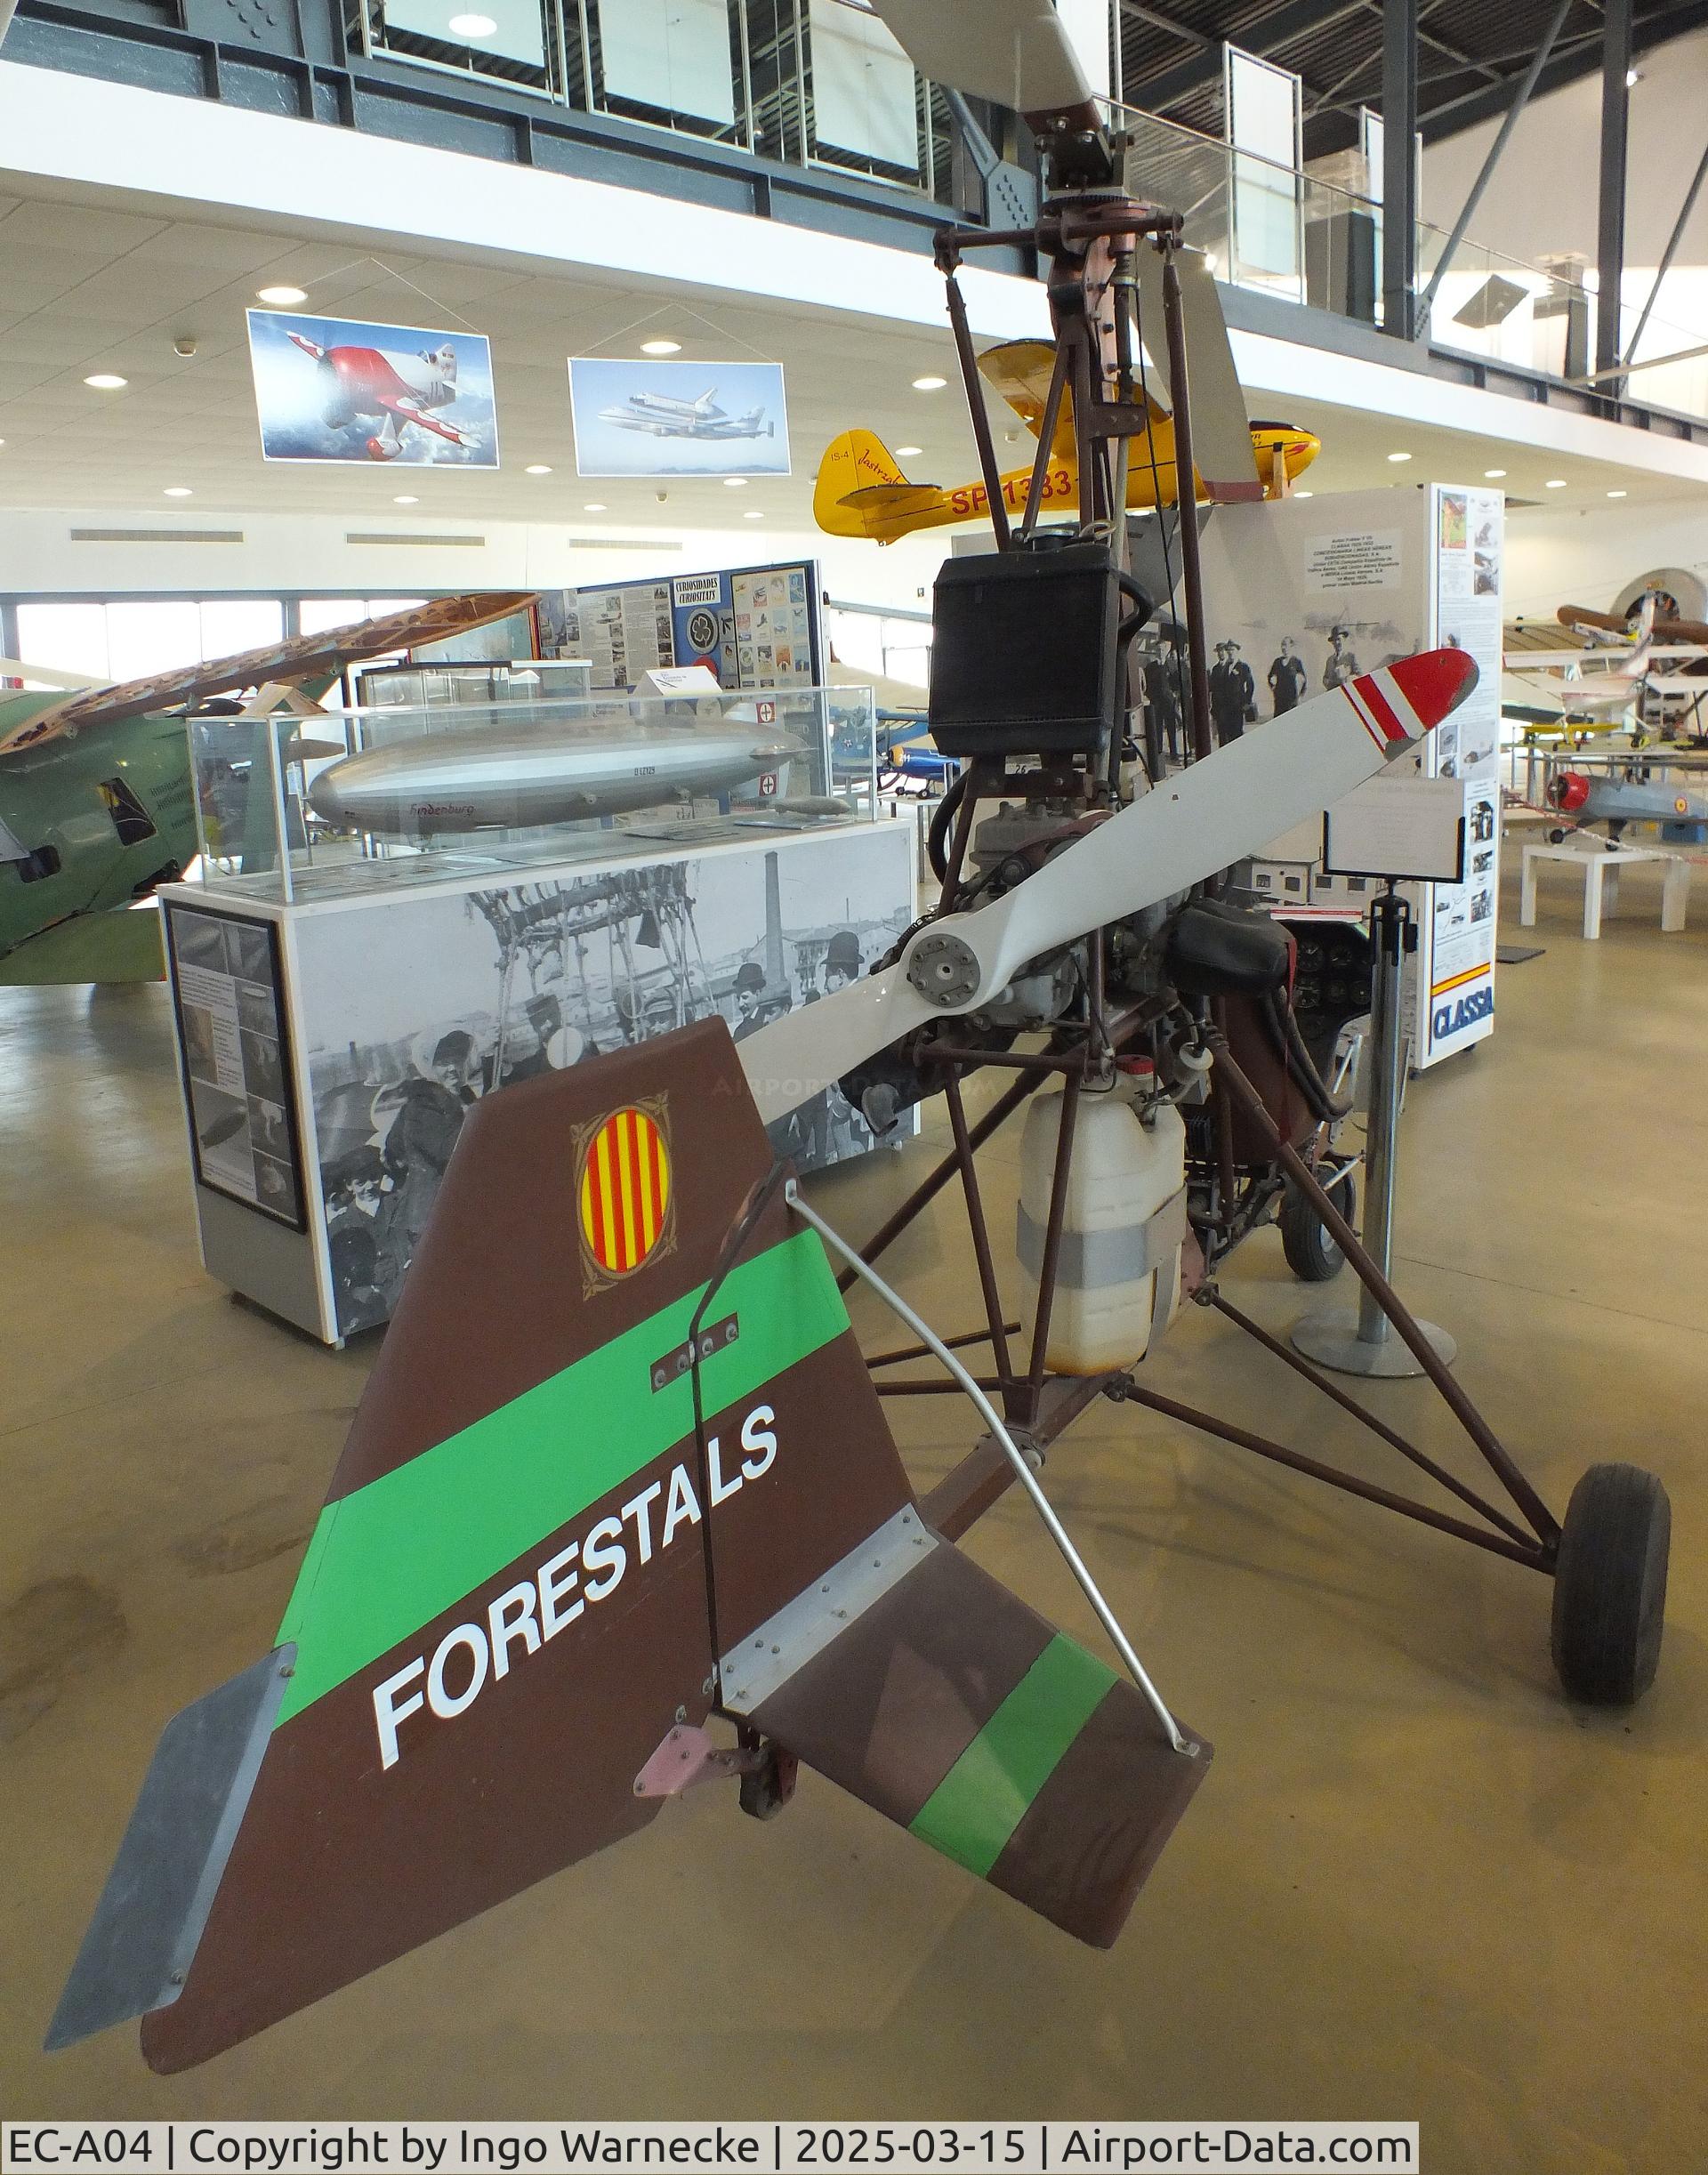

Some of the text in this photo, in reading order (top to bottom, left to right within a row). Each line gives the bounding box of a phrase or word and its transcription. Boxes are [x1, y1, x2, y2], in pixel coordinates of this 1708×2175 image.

[830, 450, 850, 463] IS-4
[675, 577, 719, 592] CURIOSIDADES
[678, 590, 716, 605] CURIOSITATS
[372, 1406, 777, 1770] FORESTALS
